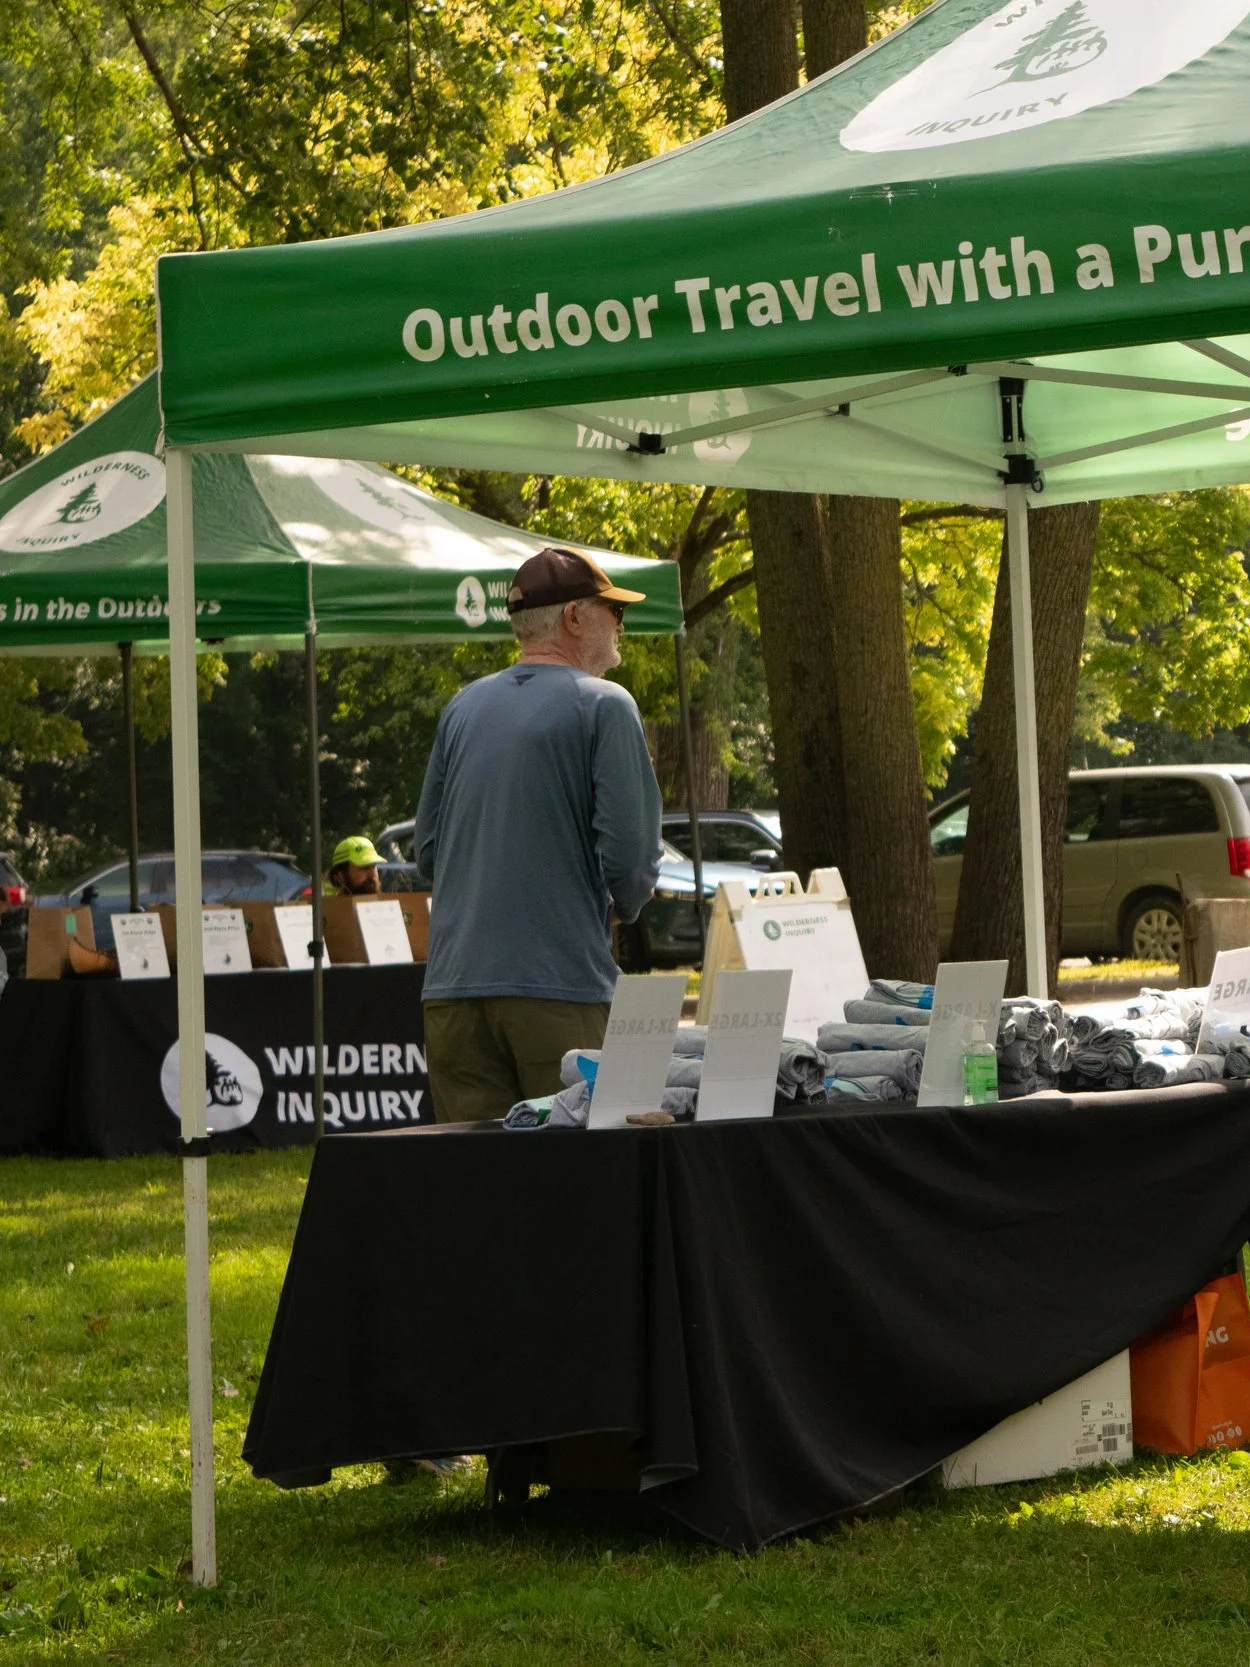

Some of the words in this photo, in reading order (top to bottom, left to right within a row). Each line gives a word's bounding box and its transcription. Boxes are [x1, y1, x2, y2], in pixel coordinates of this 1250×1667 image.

[905, 92, 1068, 136] INQUIRY
[402, 292, 659, 362] Outdoor
[675, 253, 882, 333] Travel
[897, 235, 1054, 308] with
[1076, 242, 1114, 291] a
[60, 462, 151, 487] WILDERNESS
[13, 597, 39, 622] in
[47, 597, 91, 621] the
[98, 595, 222, 619] Outdrs
[264, 1043, 429, 1076] WILDERN
[276, 1089, 424, 1128] INQUIRY
